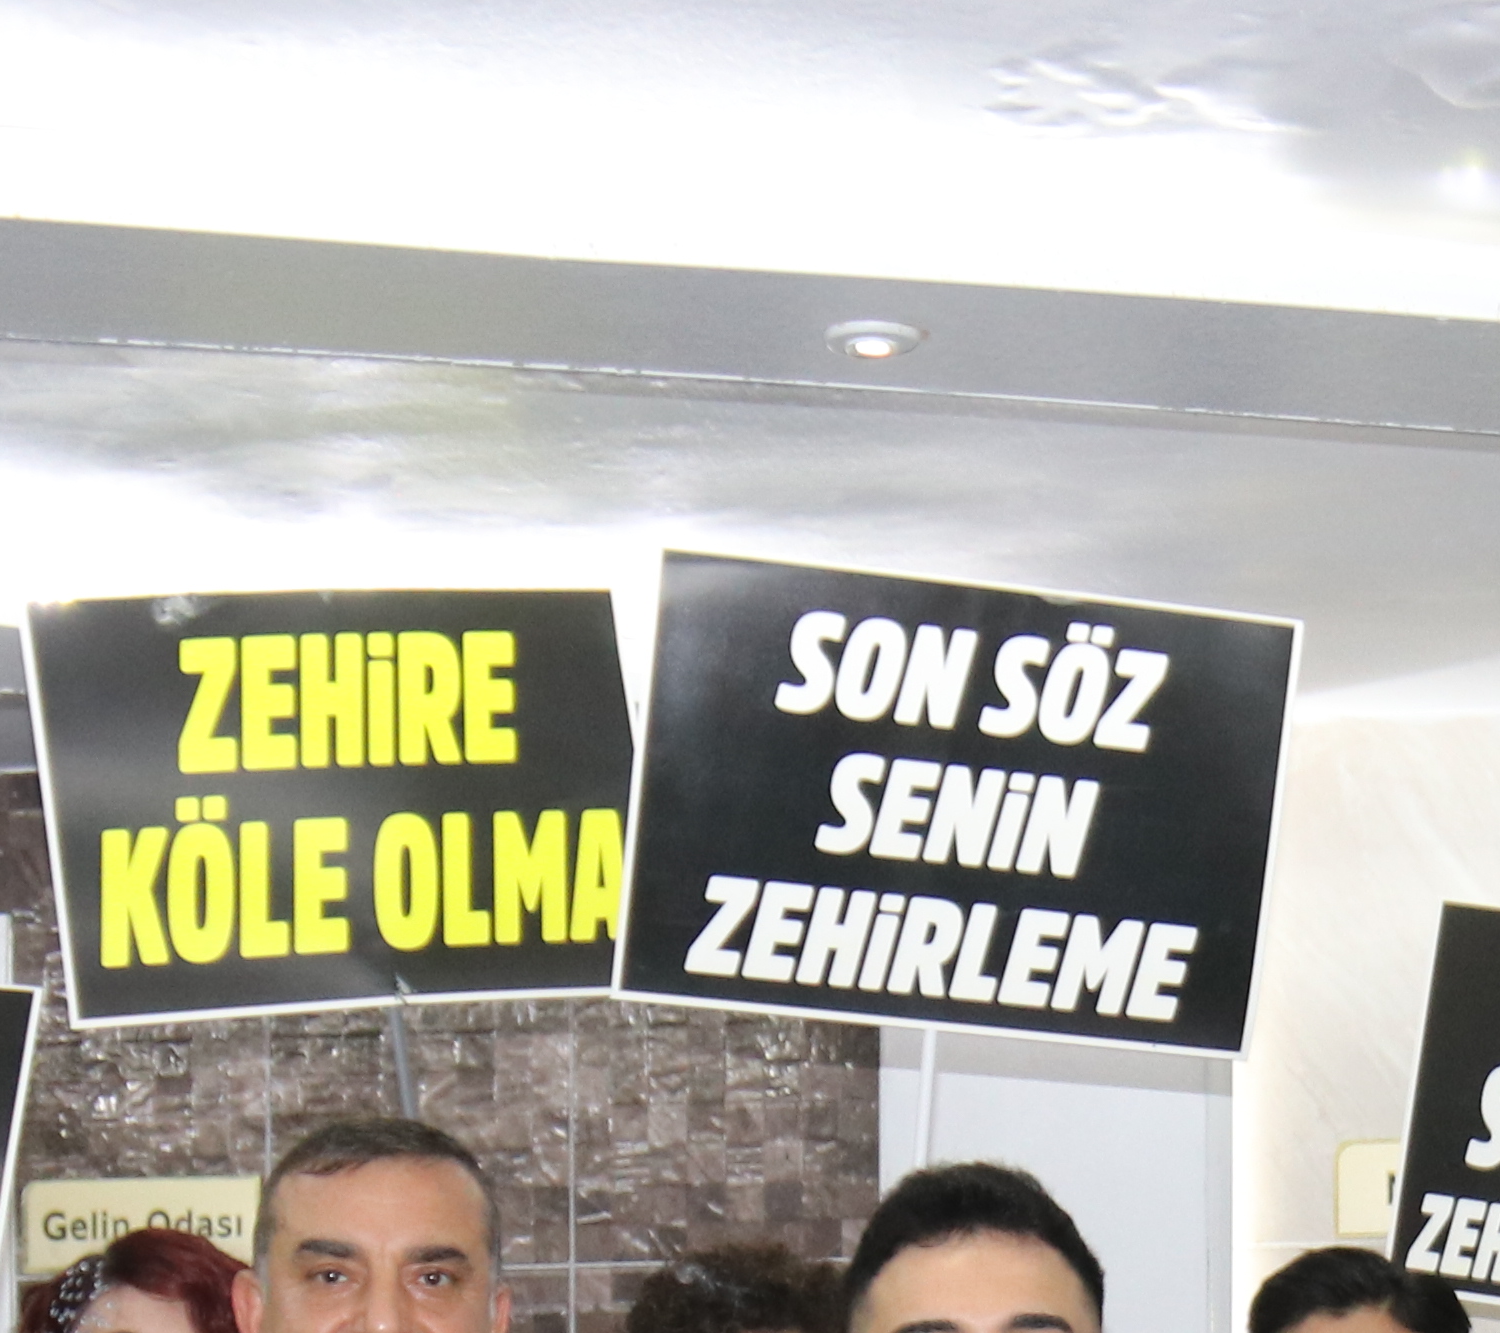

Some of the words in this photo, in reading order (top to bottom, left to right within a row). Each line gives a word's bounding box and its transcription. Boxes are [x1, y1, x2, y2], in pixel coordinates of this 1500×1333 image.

[177, 630, 518, 774] ZEHİRE
[774, 610, 978, 730] SON
[977, 622, 1169, 753] SÖZ
[100, 795, 351, 969] KÖLE
[373, 808, 625, 952] OLMA
[814, 751, 1099, 880] SENİN
[683, 874, 1197, 1023] ZEHİRLEME
[43, 1212, 130, 1241] Gelin
